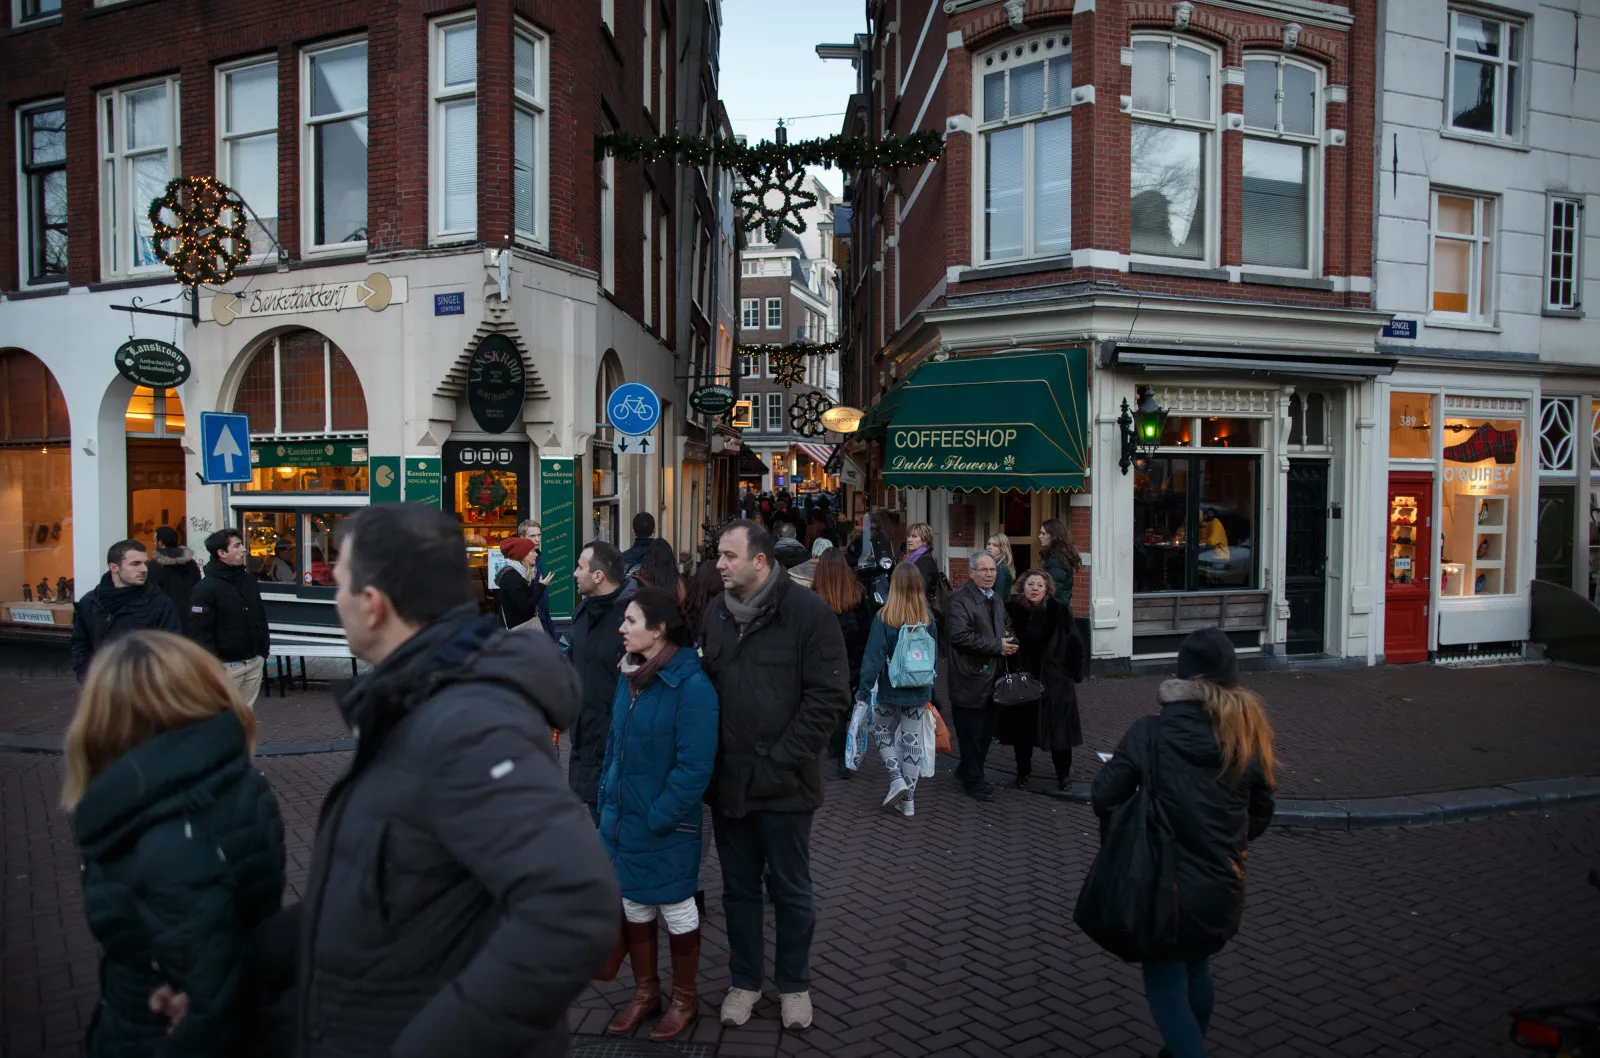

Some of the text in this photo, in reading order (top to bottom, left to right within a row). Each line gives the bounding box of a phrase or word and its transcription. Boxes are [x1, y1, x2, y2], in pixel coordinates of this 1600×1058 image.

[250, 283, 348, 313] Banketbakkerij
[437, 295, 460, 305] SINGEL
[1391, 321, 1410, 330] SINGEL
[126, 343, 183, 363] Lanskroon
[470, 350, 522, 384] LANSKROON
[1400, 415, 1417, 428] 389
[895, 429, 1017, 448] COFFEESHOP
[892, 455, 1002, 471] Dutch Flowers
[12, 612, 52, 622] EXPOSITIE
